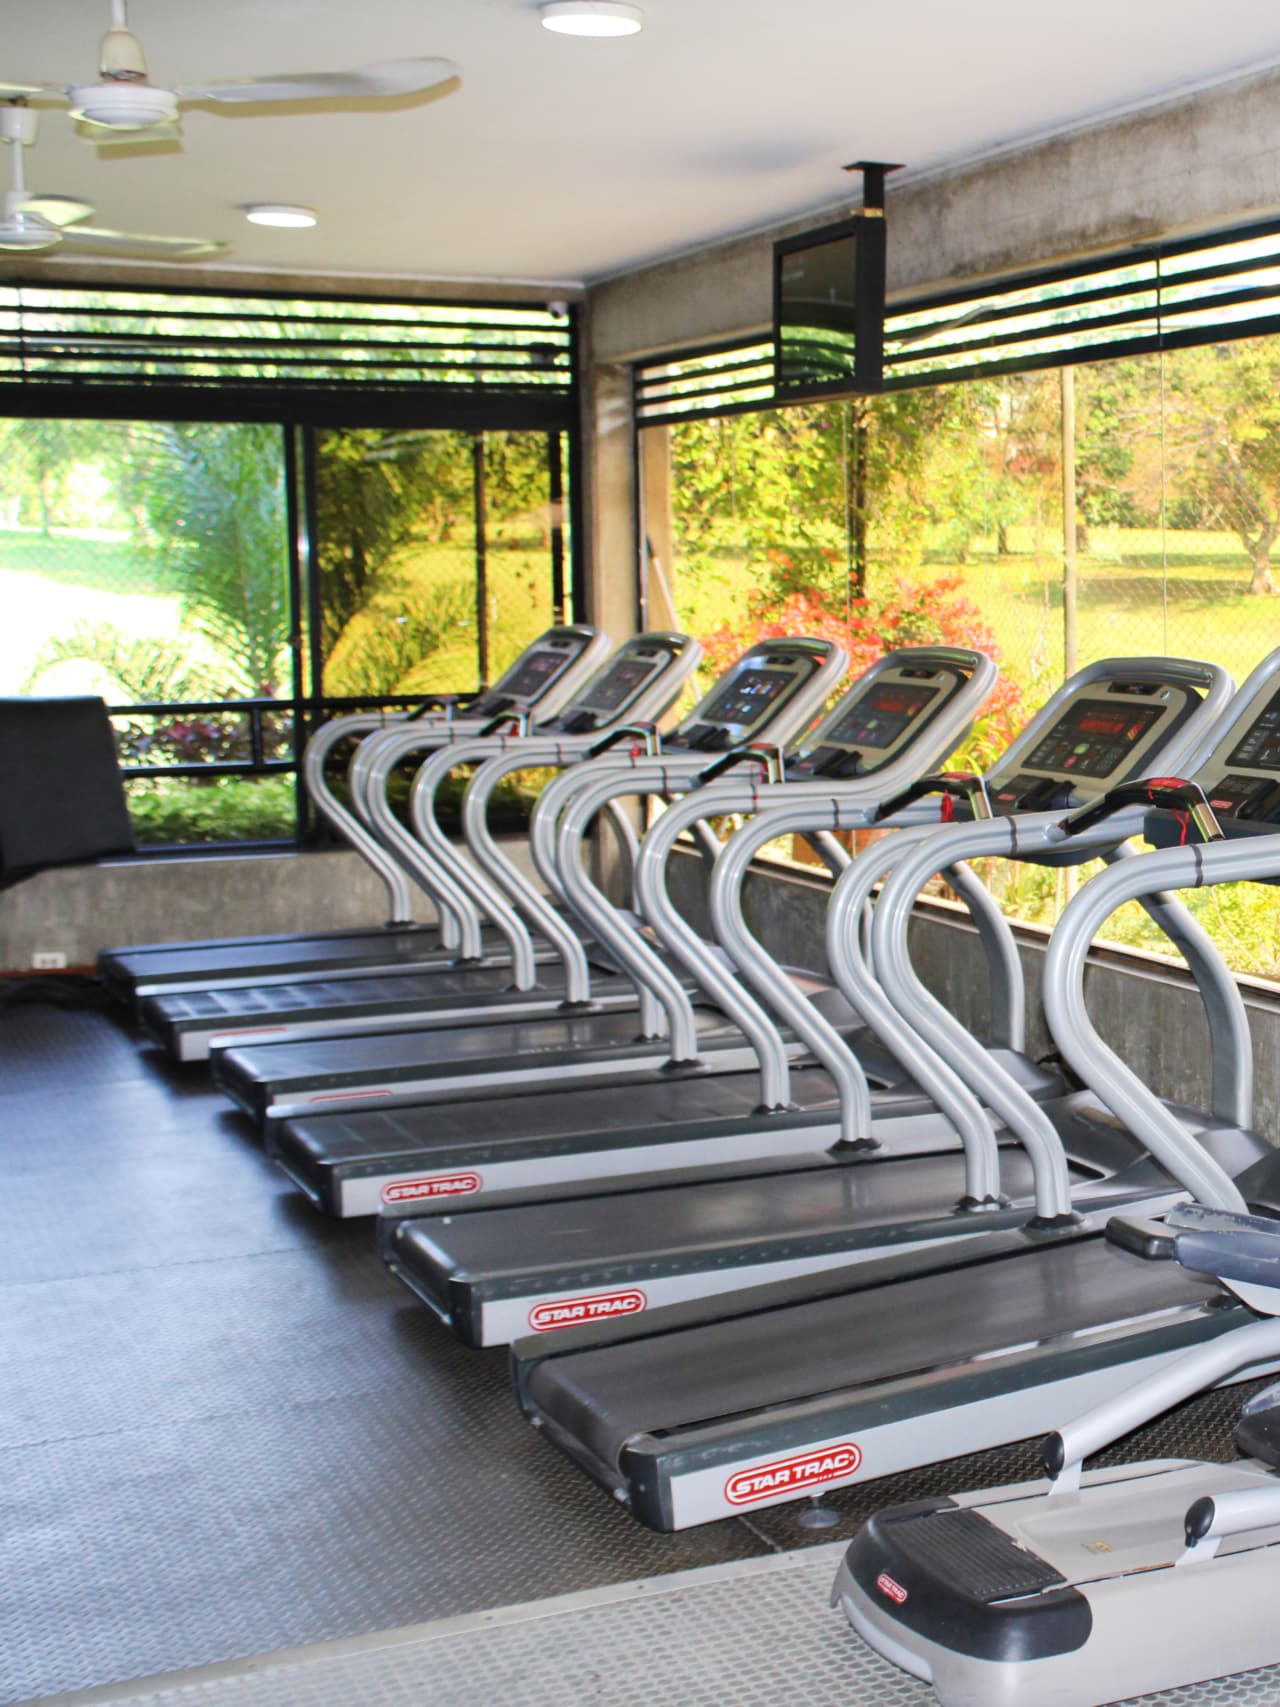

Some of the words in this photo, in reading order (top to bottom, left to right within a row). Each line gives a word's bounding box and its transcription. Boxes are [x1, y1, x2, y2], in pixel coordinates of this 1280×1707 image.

[387, 1184, 431, 1200] STAR
[432, 1179, 474, 1194] TRAC
[536, 1306, 586, 1325] STAR
[588, 1298, 638, 1315] TRAC
[733, 1469, 792, 1497] STAR
[791, 1453, 850, 1479] TRAC
